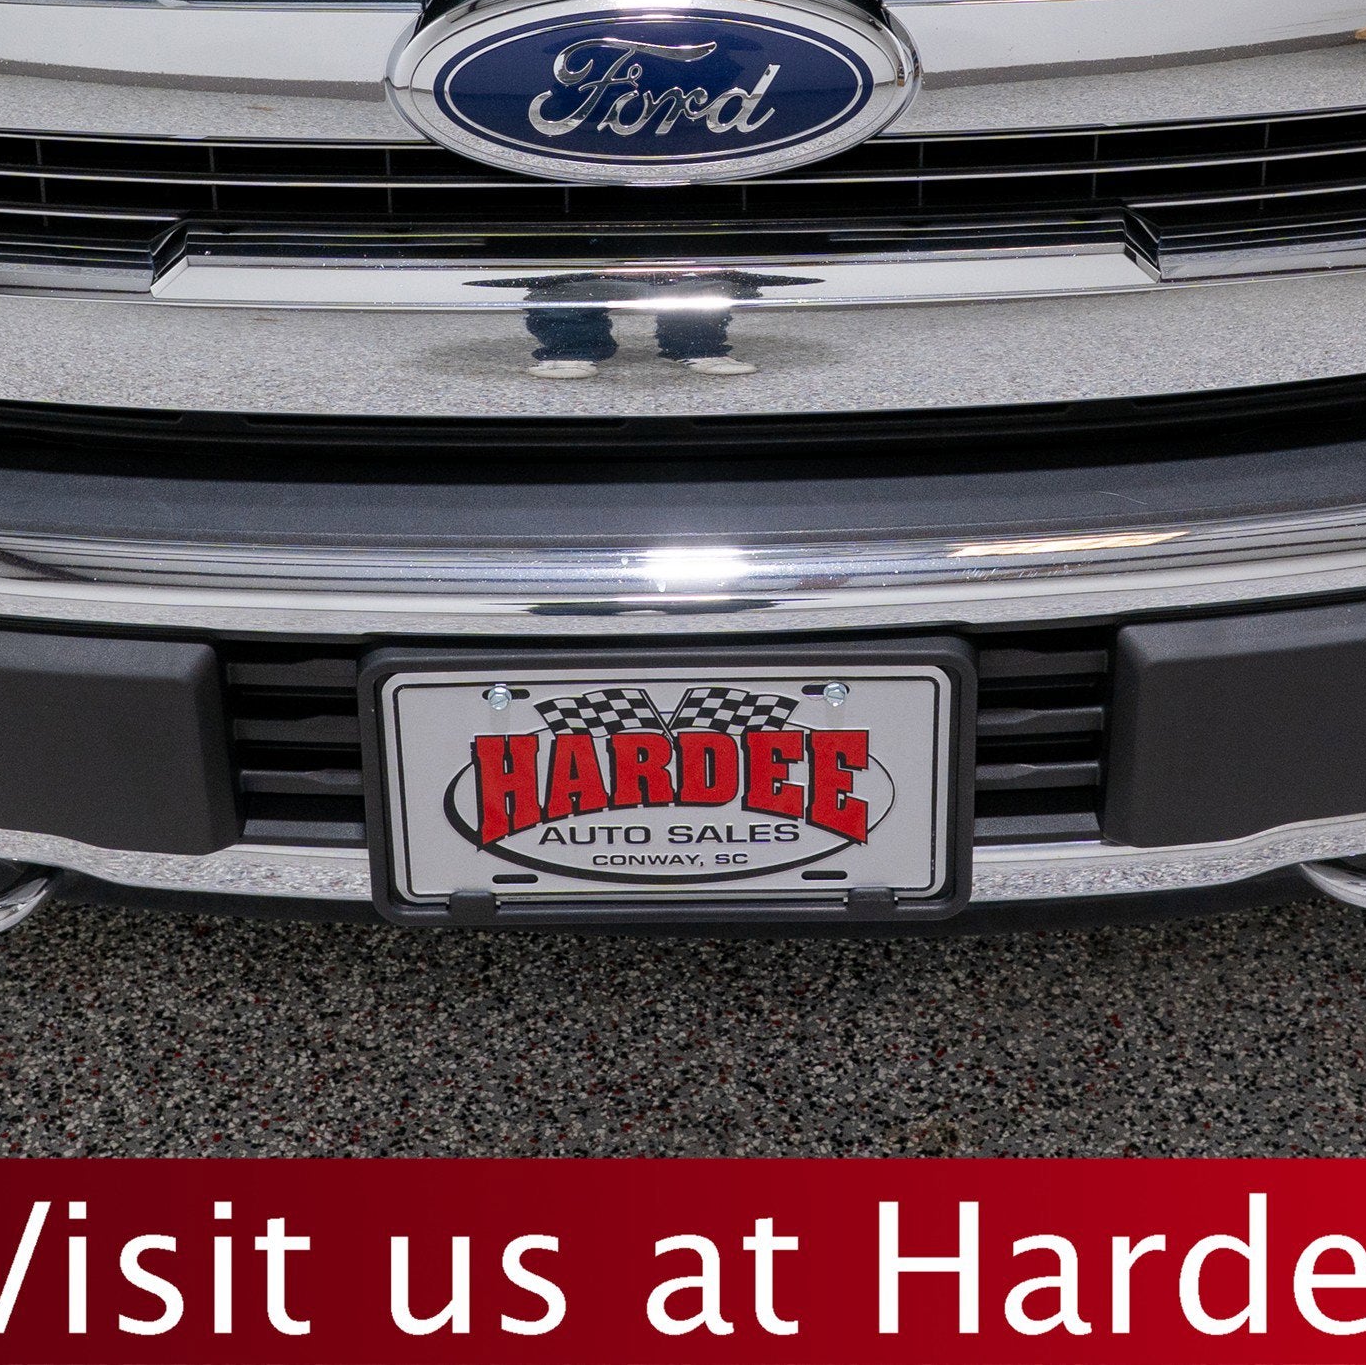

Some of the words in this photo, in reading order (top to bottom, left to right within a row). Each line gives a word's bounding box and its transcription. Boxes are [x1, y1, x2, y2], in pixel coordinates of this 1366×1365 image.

[527, 37, 780, 137] Ford
[471, 728, 871, 851] HARDEE
[538, 825, 652, 845] AUTO
[667, 822, 801, 845] SALES
[592, 853, 705, 867] CONWAY,
[715, 852, 749, 866] SC
